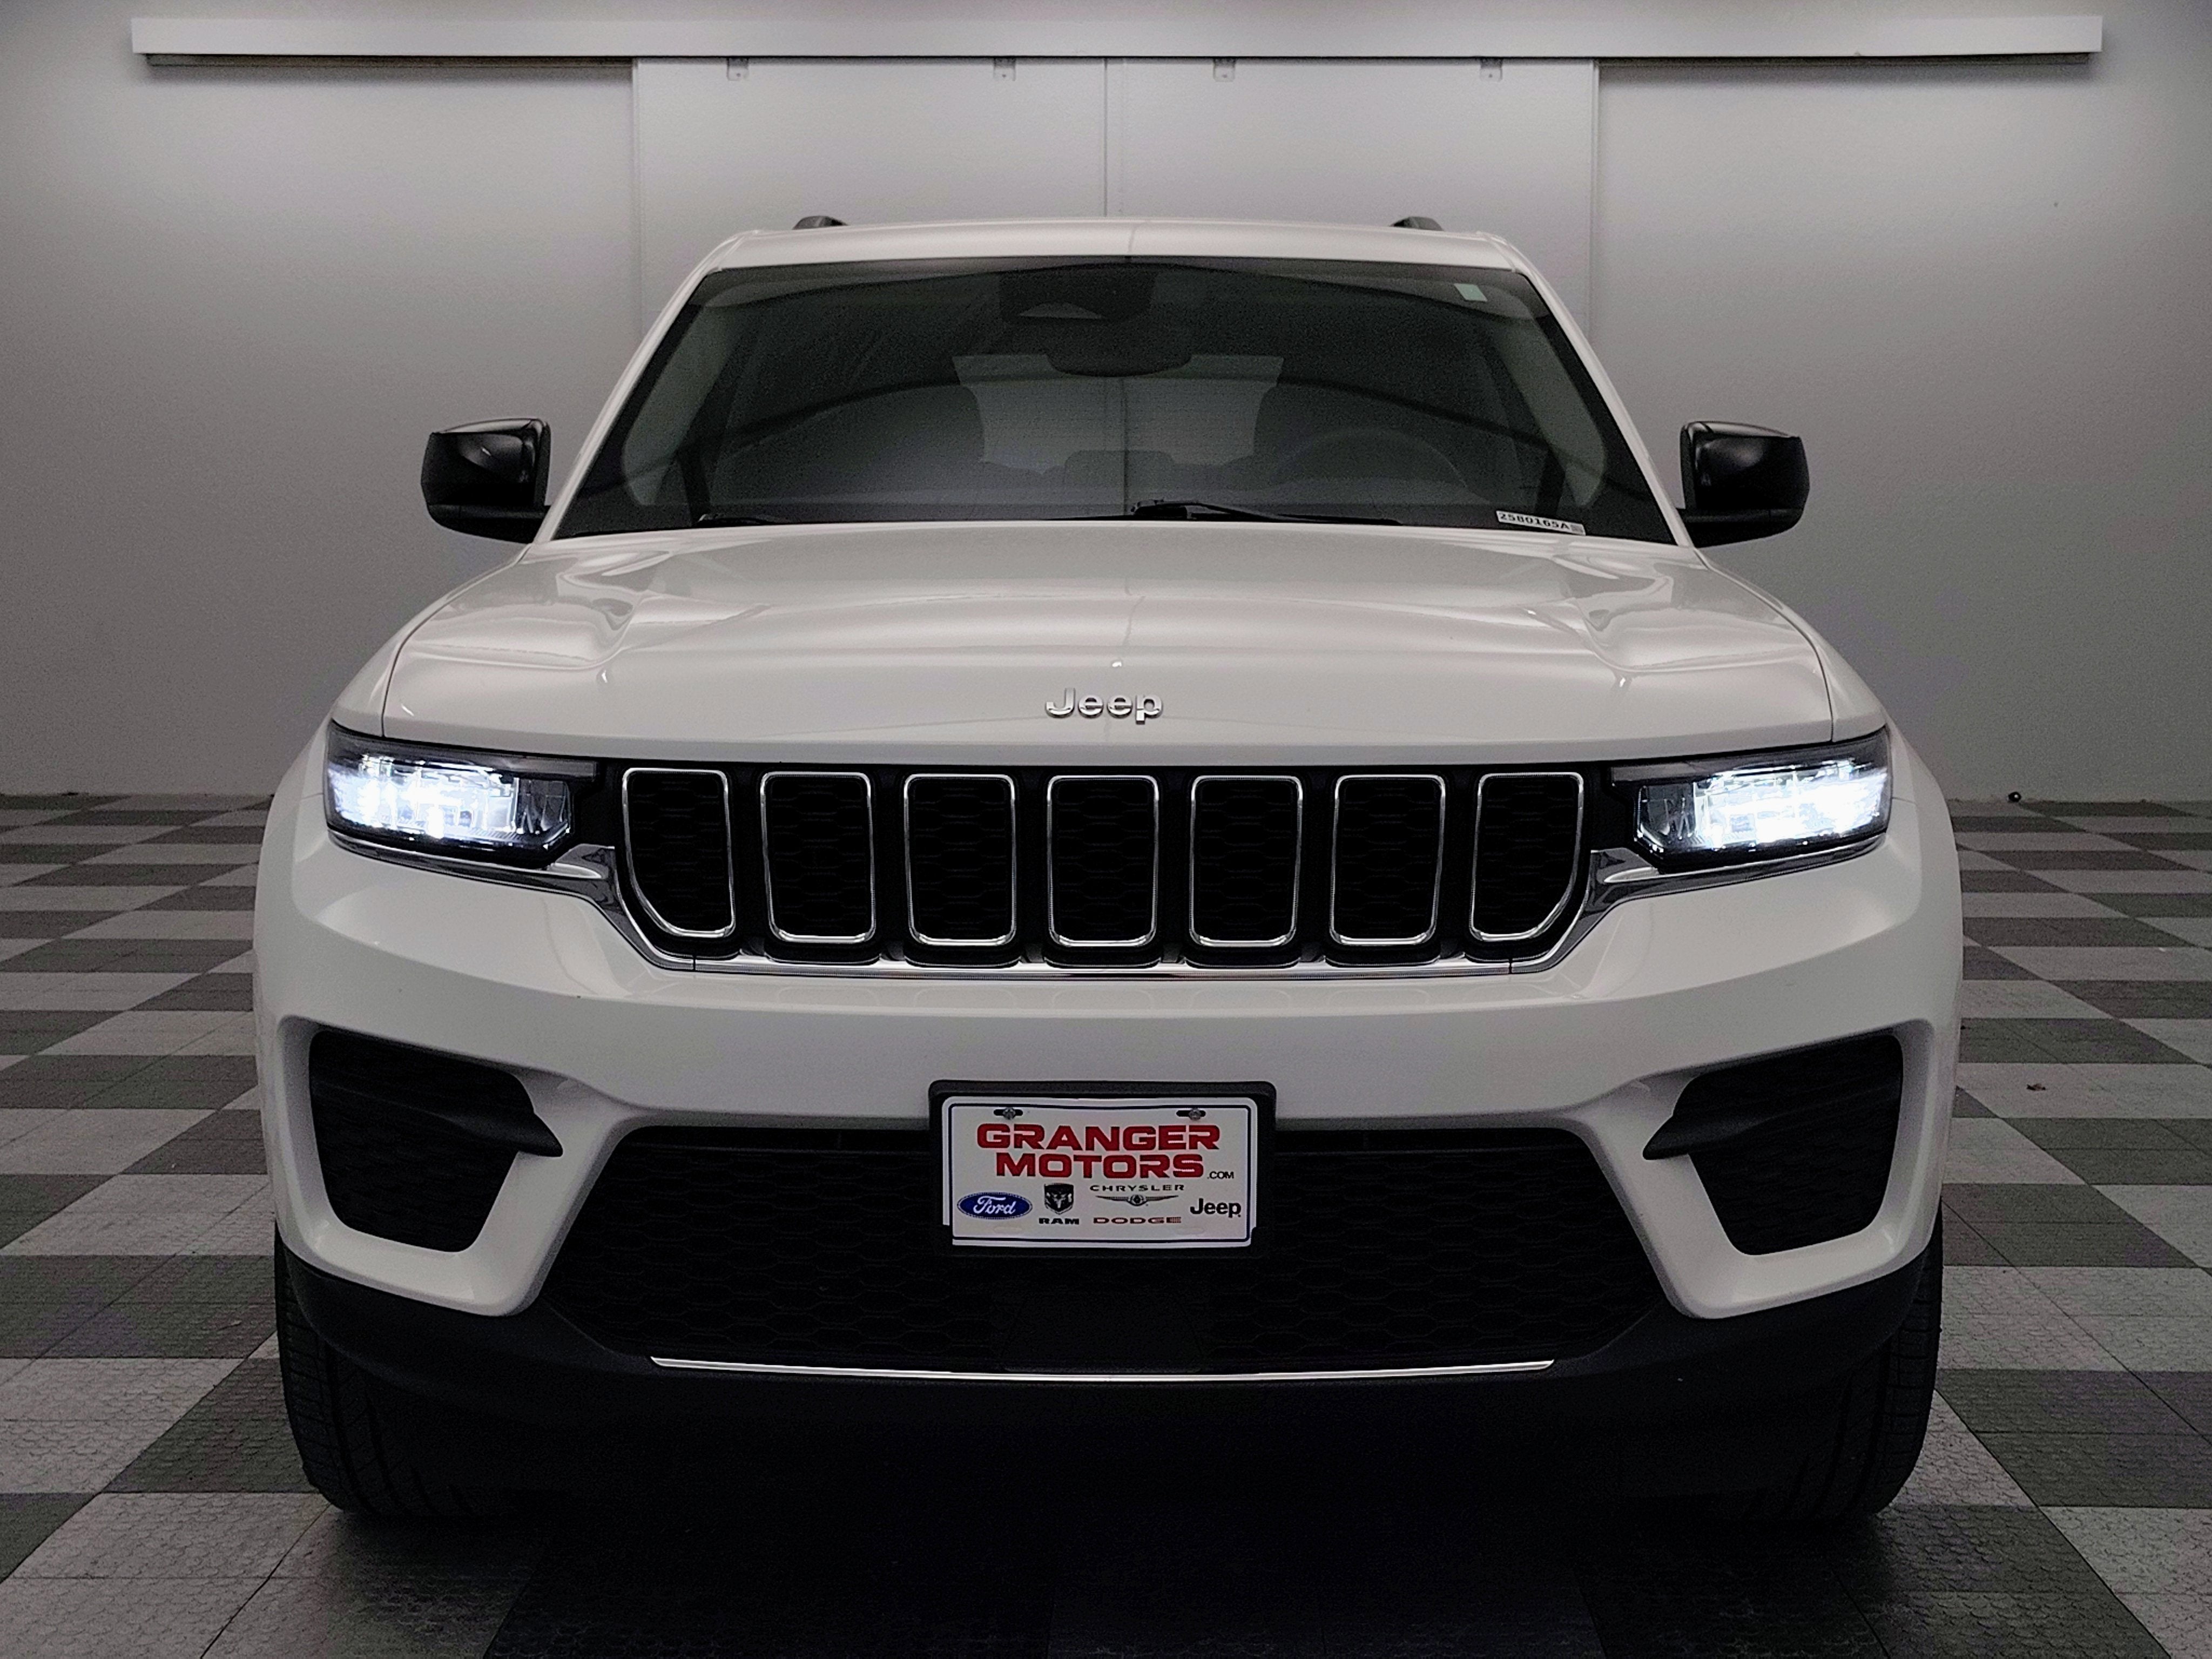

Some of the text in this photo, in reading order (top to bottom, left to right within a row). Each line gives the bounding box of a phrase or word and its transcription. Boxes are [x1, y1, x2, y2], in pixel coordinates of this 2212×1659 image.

[1046, 687, 1163, 725] Jeep
[977, 1123, 1220, 1151] GRANGER
[996, 1152, 1204, 1179] MOTORS
[973, 1196, 1016, 1215] Ford
[1190, 1198, 1242, 1218] Jeep
